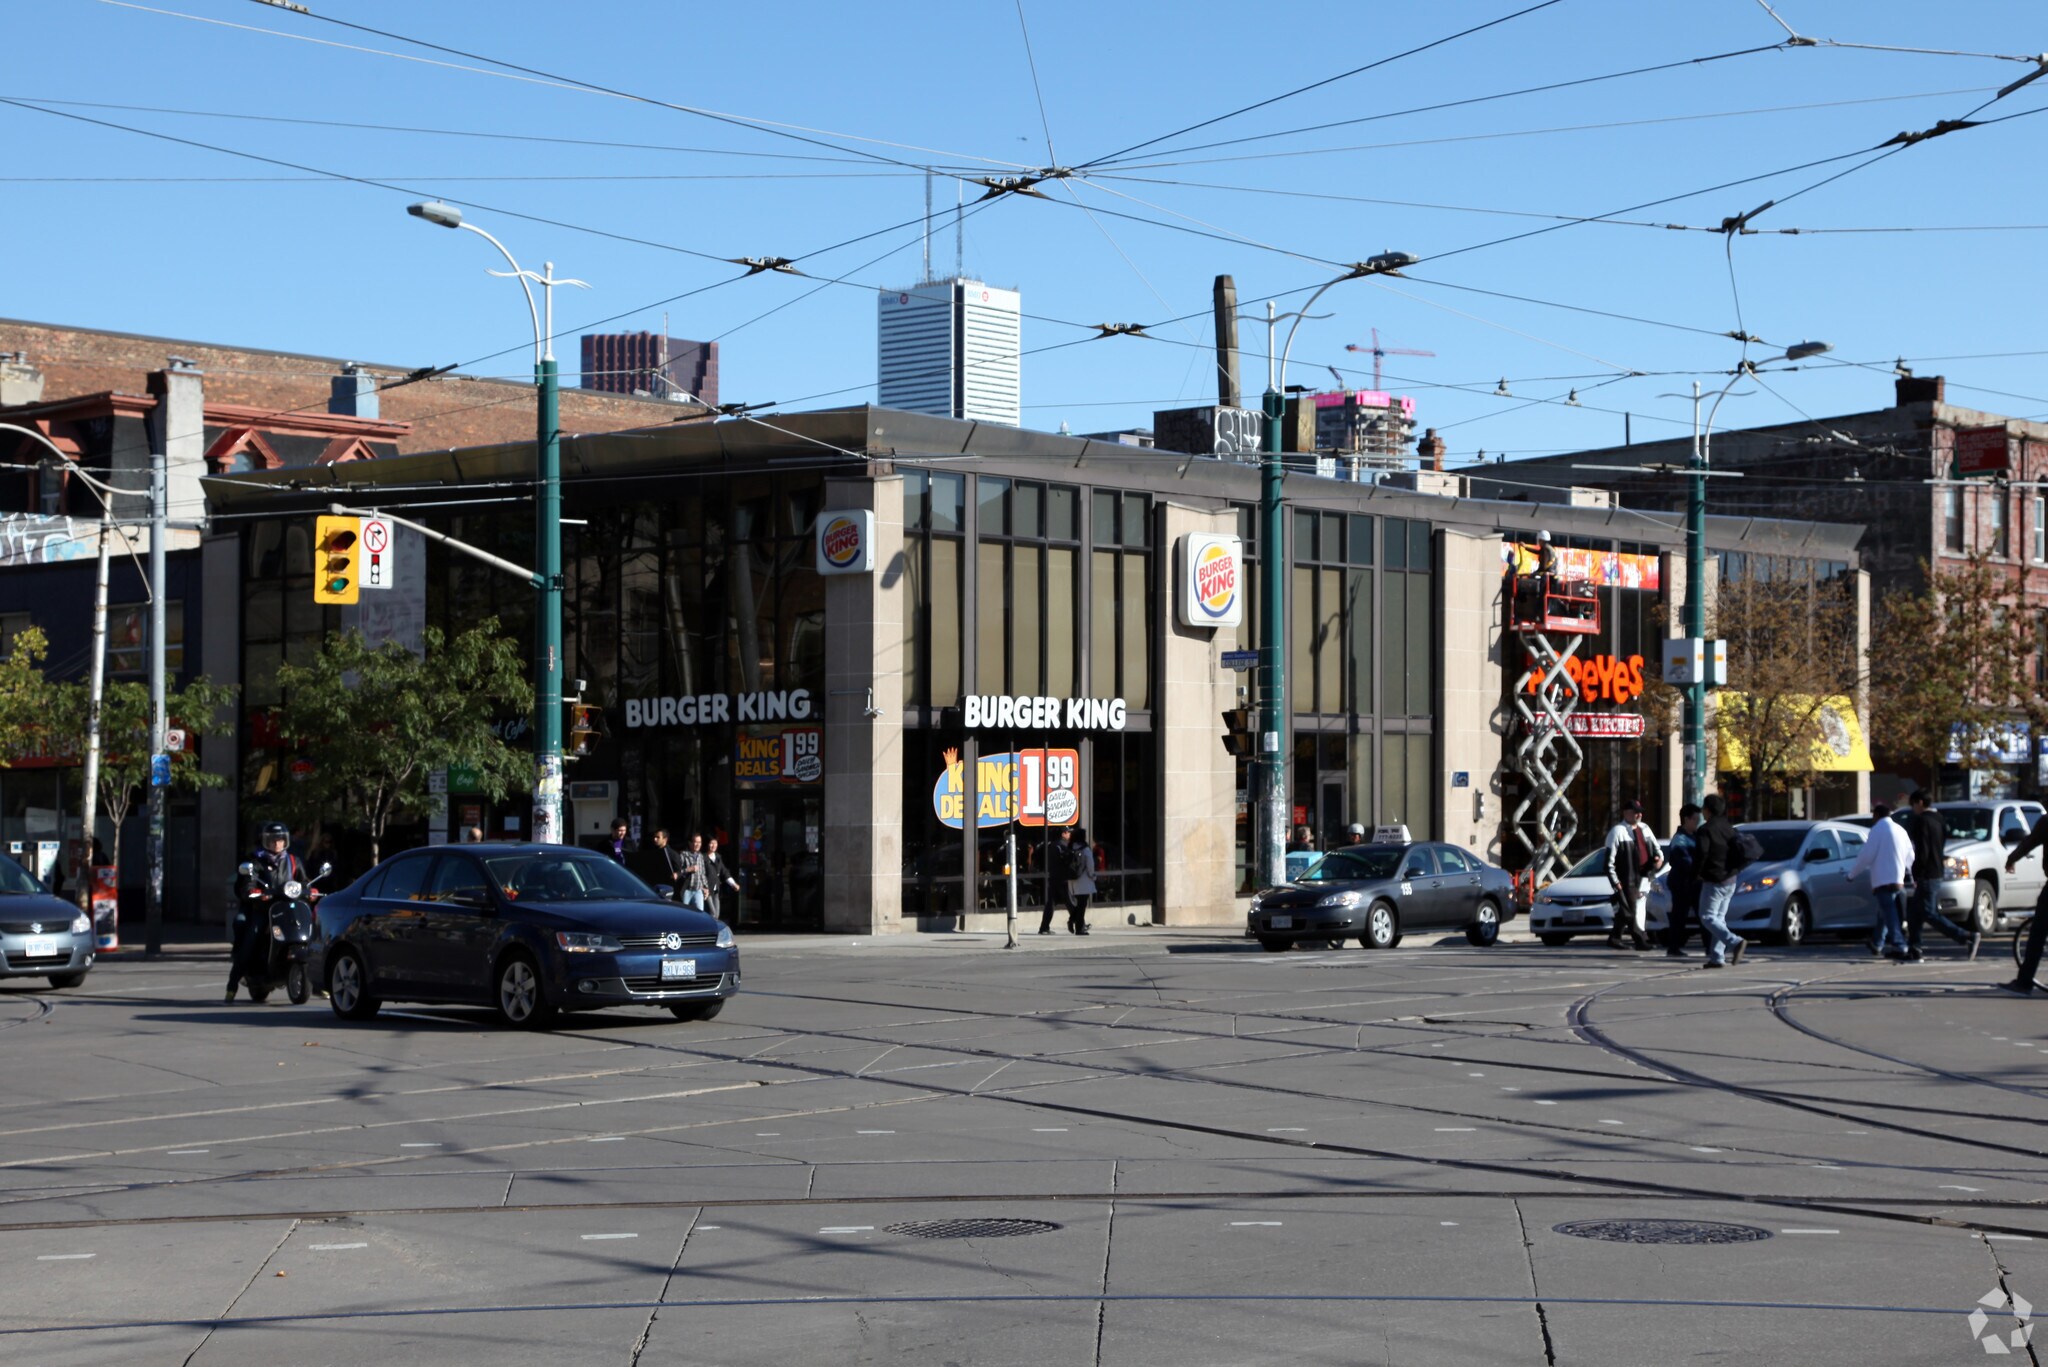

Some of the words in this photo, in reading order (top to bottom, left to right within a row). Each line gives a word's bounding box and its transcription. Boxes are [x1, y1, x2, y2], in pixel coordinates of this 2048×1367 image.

[825, 524, 858, 545] BURGER
[827, 533, 860, 558] KING
[1199, 556, 1234, 583] BURGER
[1200, 569, 1235, 602] KING
[625, 693, 730, 728] BURGER
[737, 688, 811, 721] KING
[965, 695, 1061, 729] BURGER
[1066, 698, 1126, 729] KING
[1590, 717, 1641, 733] KITCHEN
[740, 738, 780, 759] KING
[735, 760, 780, 777] DEALS
[948, 760, 1019, 793] KING
[940, 794, 1019, 819] DEALS
[1047, 797, 1076, 811] SANDWICH
[1049, 791, 1068, 801] DAILY
[1048, 809, 1073, 820] SPECIALS
